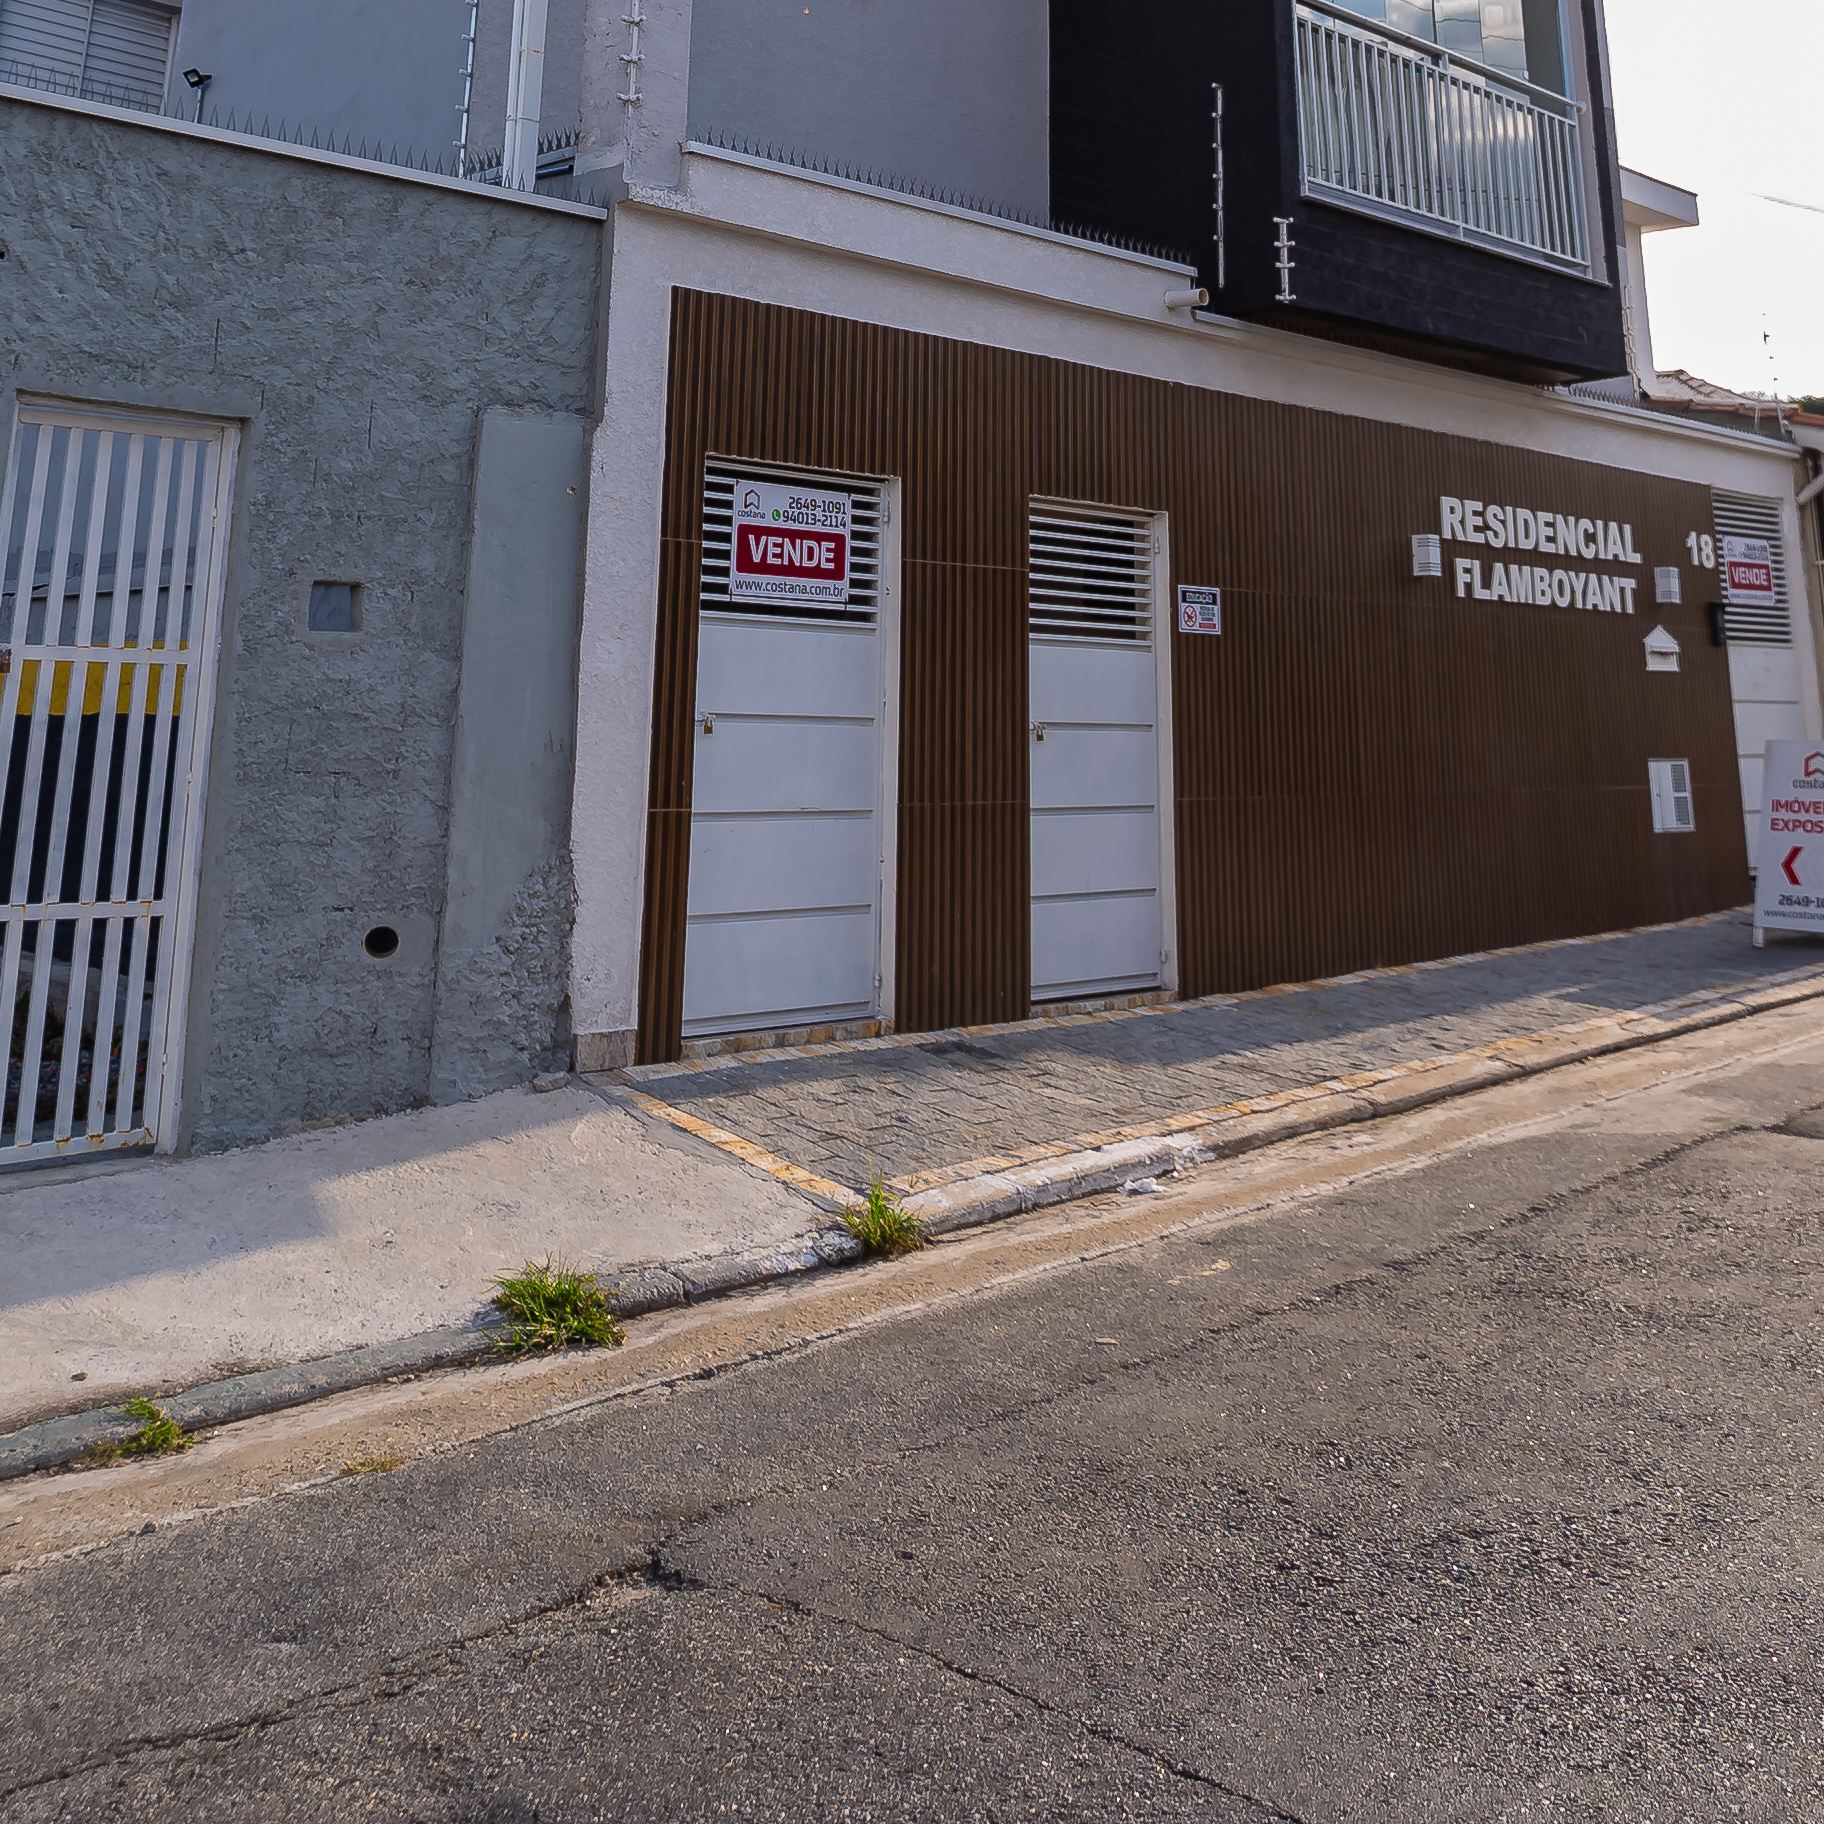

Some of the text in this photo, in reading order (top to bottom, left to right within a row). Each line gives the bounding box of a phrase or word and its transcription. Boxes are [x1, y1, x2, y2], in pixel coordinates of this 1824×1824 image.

[737, 508, 766, 520] costana
[788, 496, 847, 515] 2649-1091
[782, 509, 847, 529] 94013-2114
[1439, 496, 1643, 564] RESIDENCIAL
[748, 534, 835, 569] VENDE
[1685, 530, 1716, 569] 18
[1454, 557, 1637, 614] FLAMBOYANT
[1731, 567, 1769, 585] VENDE
[735, 579, 845, 597] www.costana.com.br
